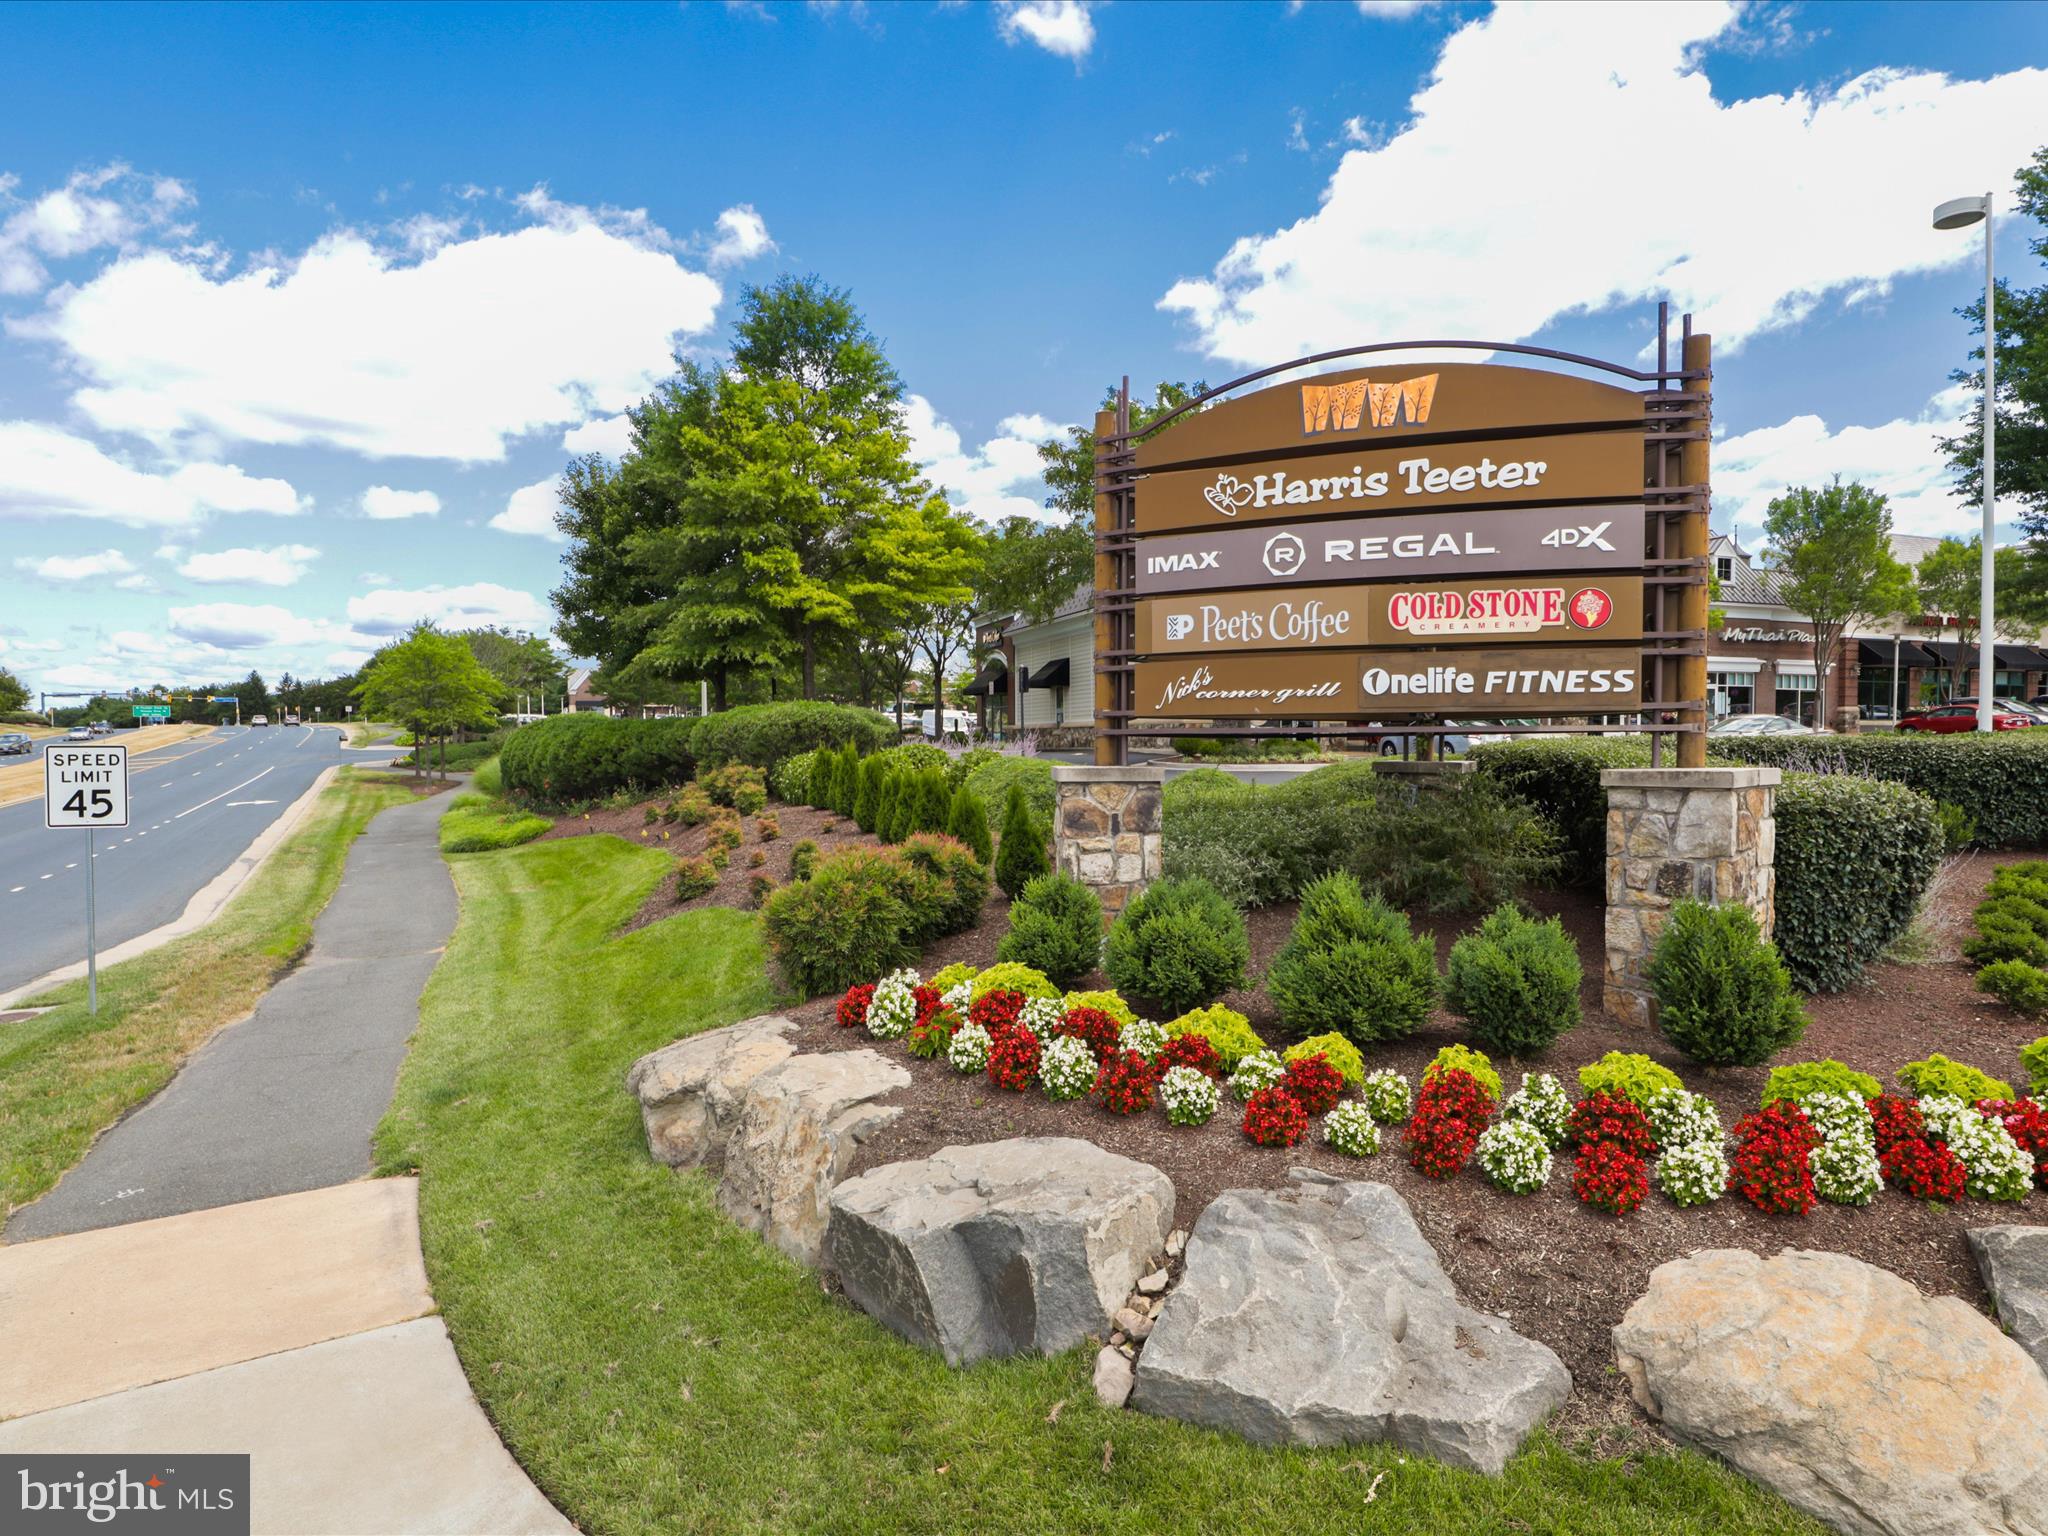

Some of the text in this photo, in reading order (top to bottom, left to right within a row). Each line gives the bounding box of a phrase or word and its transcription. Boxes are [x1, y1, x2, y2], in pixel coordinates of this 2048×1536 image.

[1252, 457, 1548, 508] Harris Teeter
[1324, 532, 1497, 563] REGAL
[1541, 521, 1617, 551] 4DX
[1147, 551, 1221, 575] IMAX
[1199, 600, 1350, 643] Peet's Coffee
[1390, 589, 1563, 627] COLD STONE
[1419, 621, 1531, 631] CREAMERY
[1155, 665, 1214, 709] Nick's
[1195, 681, 1342, 704] corner grill
[1362, 667, 1635, 696] Onelife FITNESS
[53, 753, 121, 767] SPEED
[60, 770, 113, 784] LIMIT
[62, 789, 114, 818] 45
